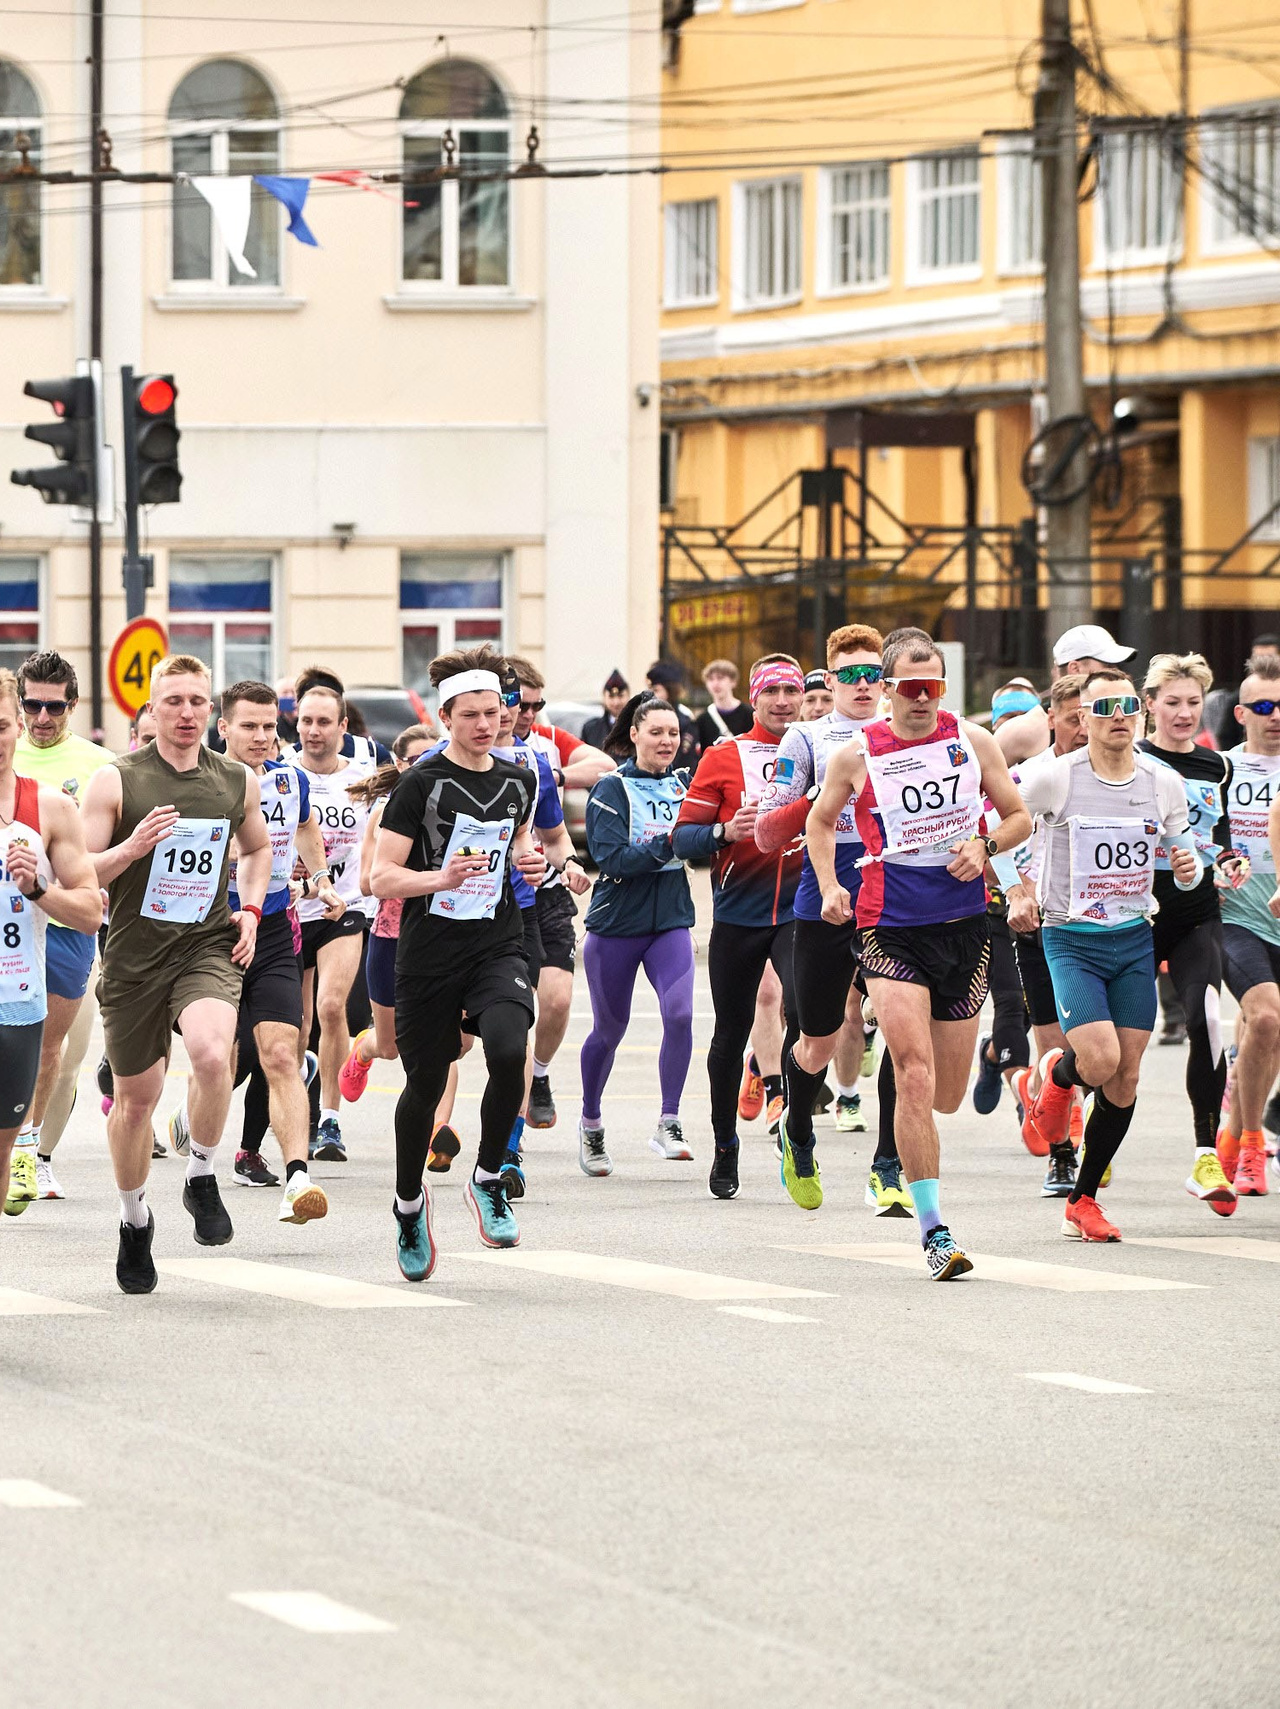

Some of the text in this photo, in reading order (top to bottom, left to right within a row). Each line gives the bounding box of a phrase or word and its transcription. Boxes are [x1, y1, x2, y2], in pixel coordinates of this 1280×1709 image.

[901, 773, 961, 814] 037
[1235, 782, 1280, 807] 04
[260, 801, 286, 827] 54
[902, 822, 945, 838] КРАСНЫЙ
[164, 848, 213, 875] 198
[1094, 841, 1149, 870] 083
[157, 889, 188, 898] ЗОЛОТОМ
[1079, 891, 1085, 899] В
[1087, 880, 1128, 890] КРАСНЫЙ
[1, 960, 24, 968] РУБИН
